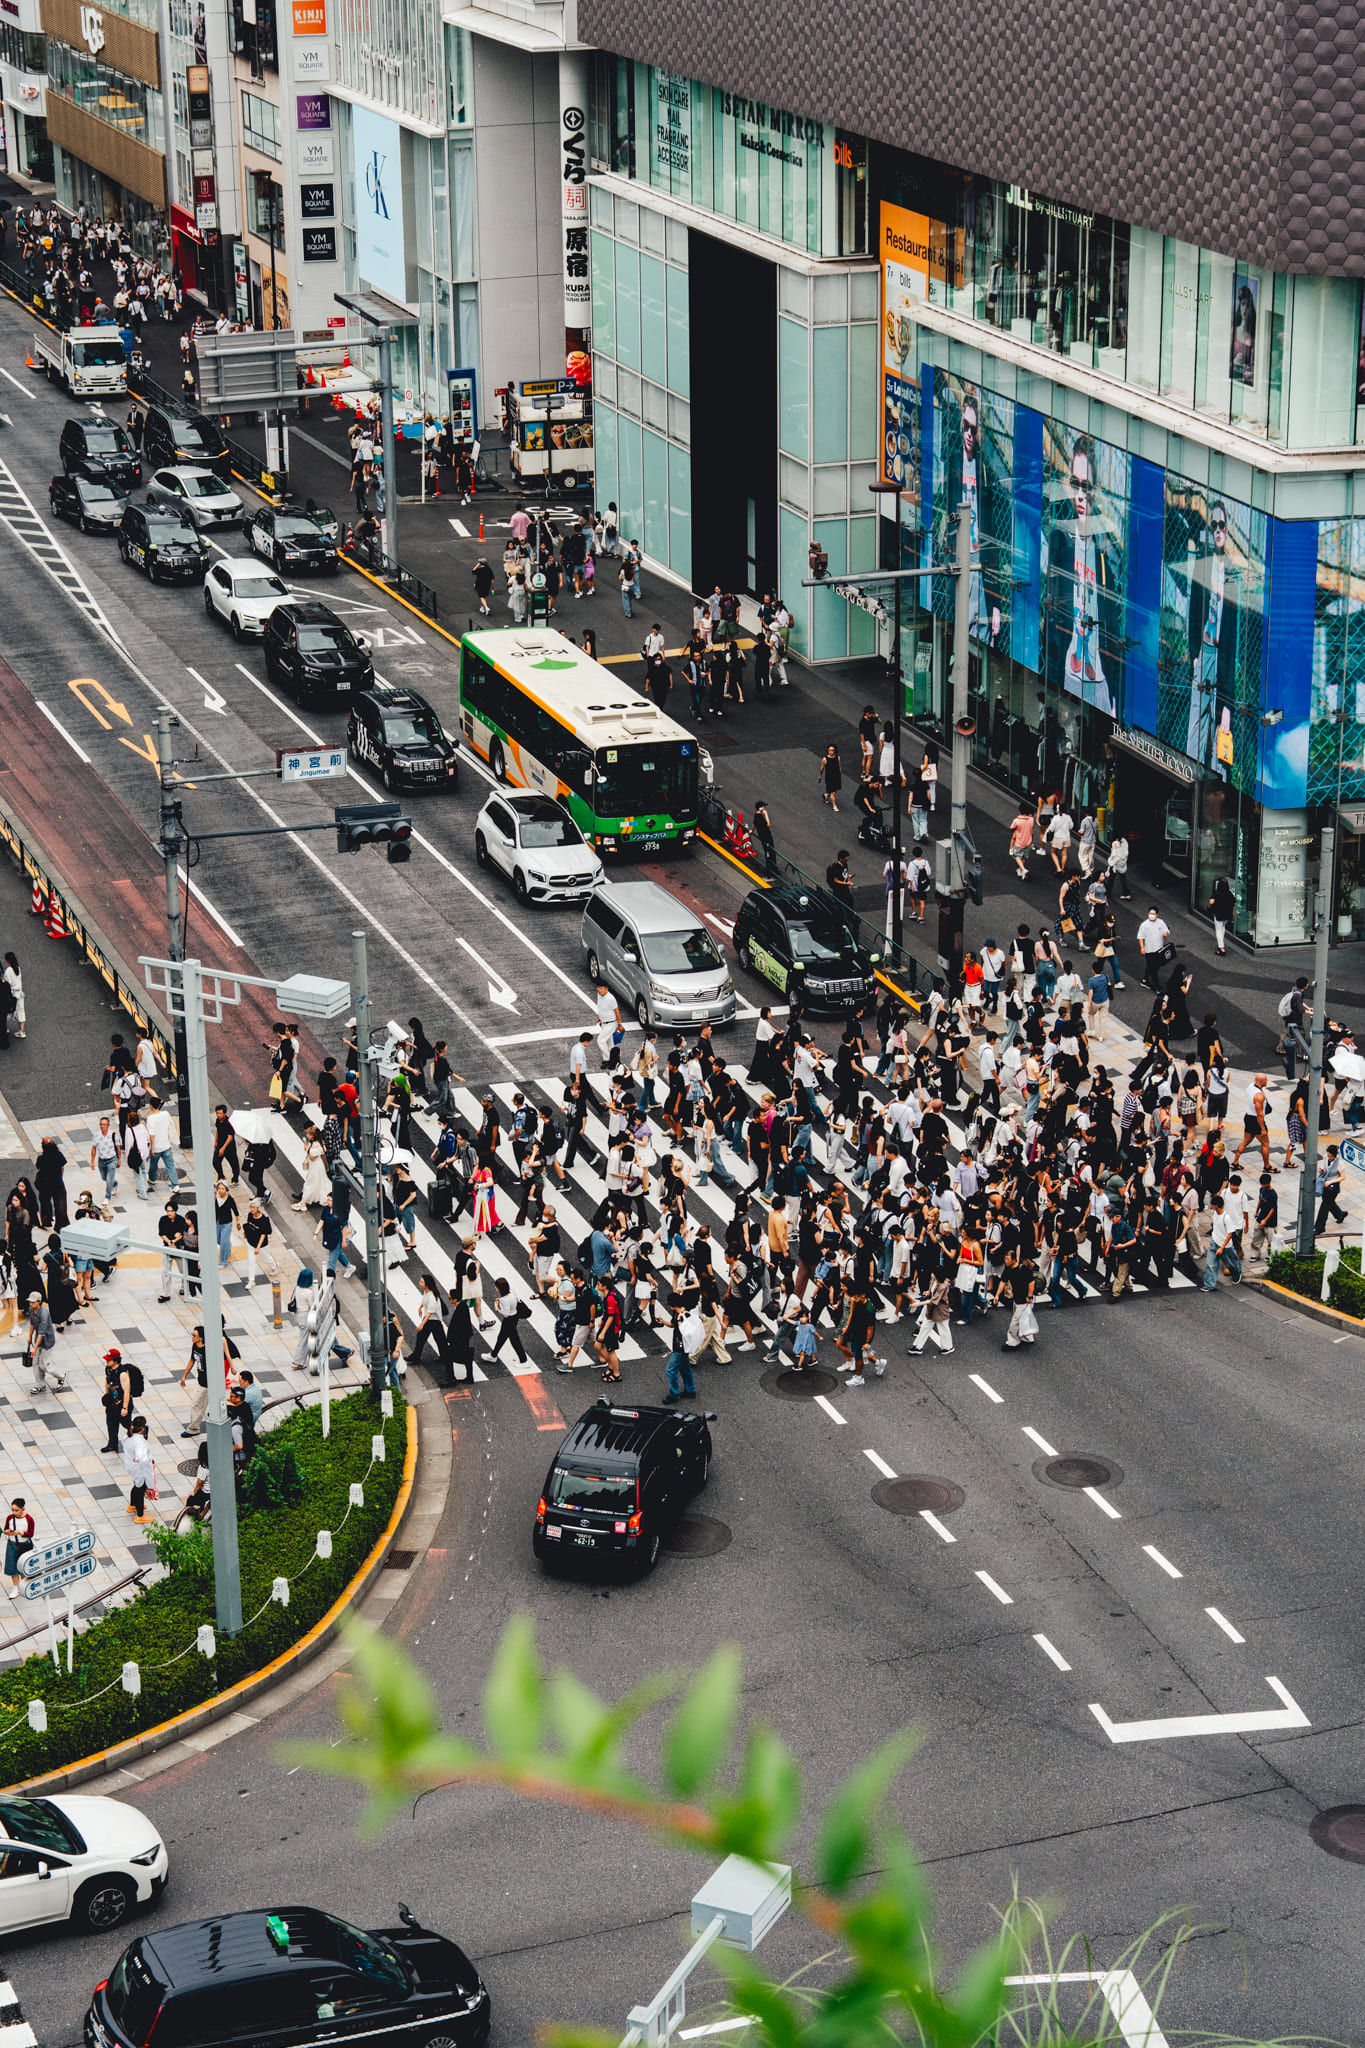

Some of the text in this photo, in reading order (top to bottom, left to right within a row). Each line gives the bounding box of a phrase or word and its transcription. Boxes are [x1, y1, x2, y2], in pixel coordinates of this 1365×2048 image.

[294, 9, 324, 20] KINJI
[80, 5, 105, 55] UGG
[302, 52, 318, 62] YM
[658, 84, 689, 108] SKIN CARE
[304, 102, 321, 111] YM
[720, 90, 766, 128] ISETAN
[307, 146, 323, 156] YM
[563, 131, 586, 184] くら
[834, 138, 852, 168] bills
[308, 190, 325, 200] YM
[1006, 184, 1033, 211] JILL
[1035, 200, 1045, 215] by
[310, 233, 327, 244] YM
[566, 226, 588, 277] 原宿
[565, 283, 590, 292] KURA
[536, 574, 541, 582] 3
[1112, 721, 1128, 743] The
[1165, 752, 1195, 780] TOKYO
[288, 754, 342, 771] 神宮前
[299, 768, 330, 777] Jingumae
[44, 1565, 76, 1584] 明治神宮
